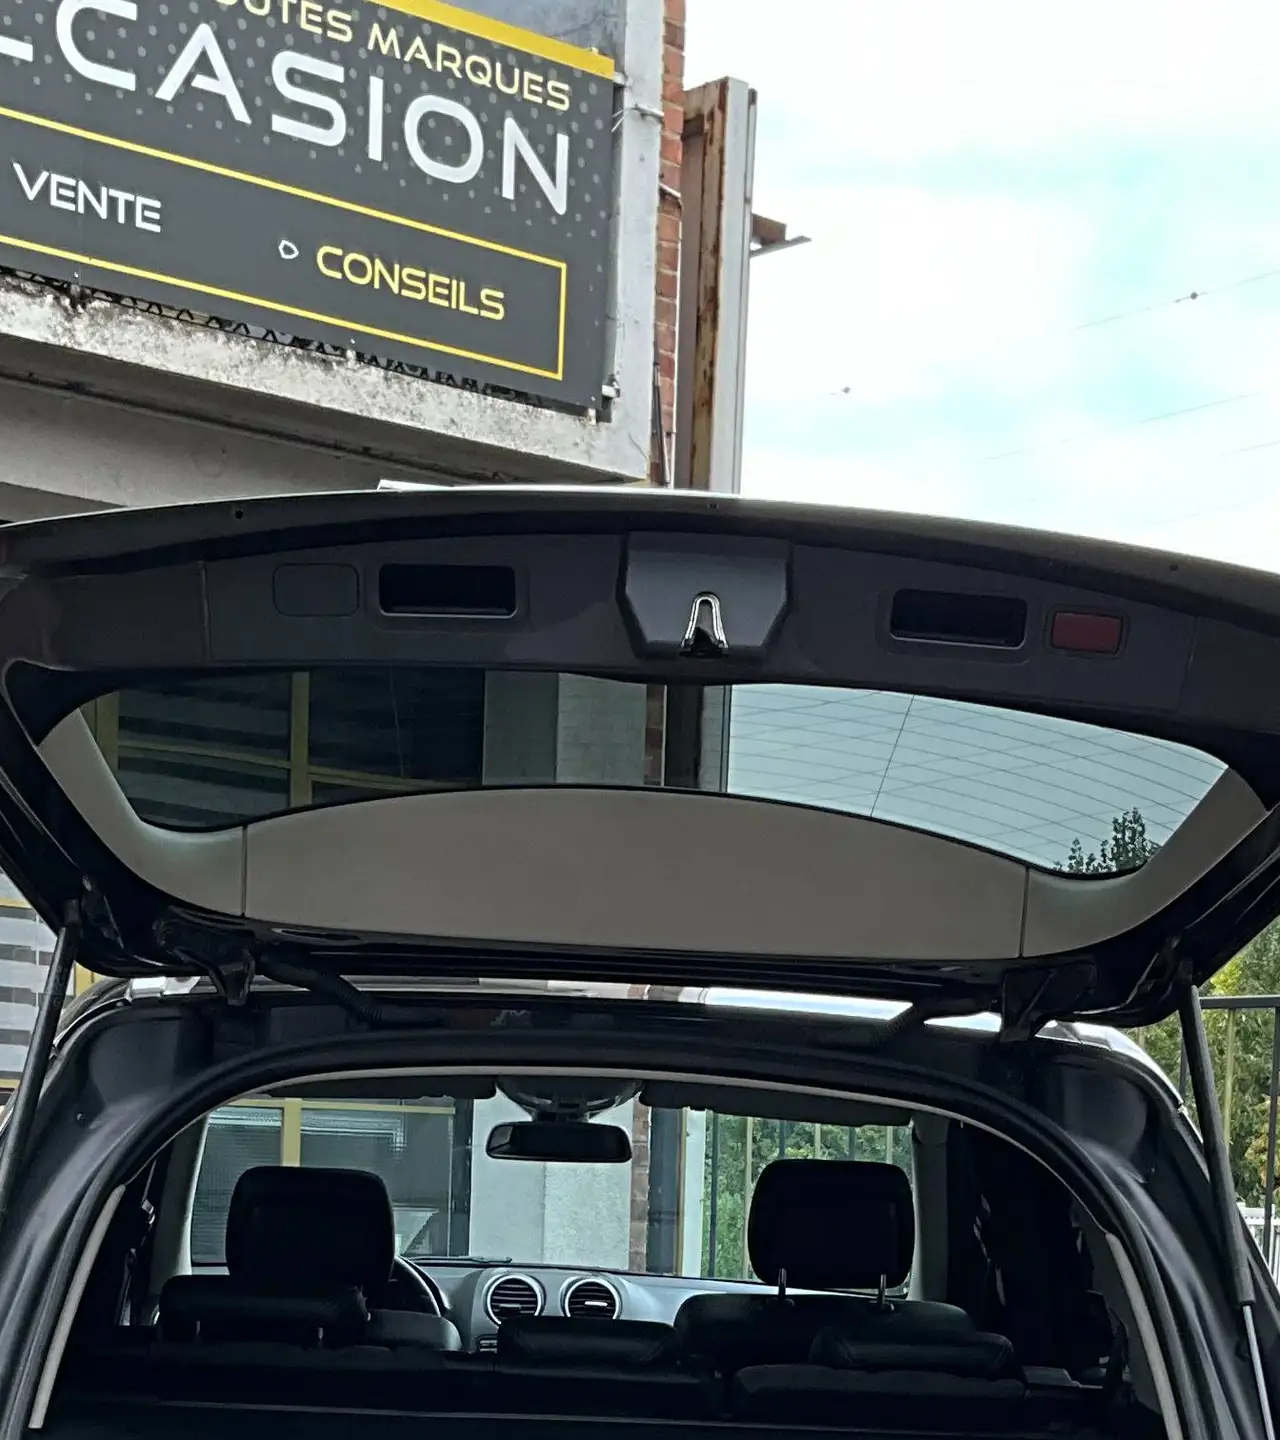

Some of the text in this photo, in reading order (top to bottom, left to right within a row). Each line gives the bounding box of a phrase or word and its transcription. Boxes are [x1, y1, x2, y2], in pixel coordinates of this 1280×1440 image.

[212, 0, 571, 112] UTES MARQUES
[12, 161, 162, 233] VENTE
[316, 245, 505, 321] CONSEILS
